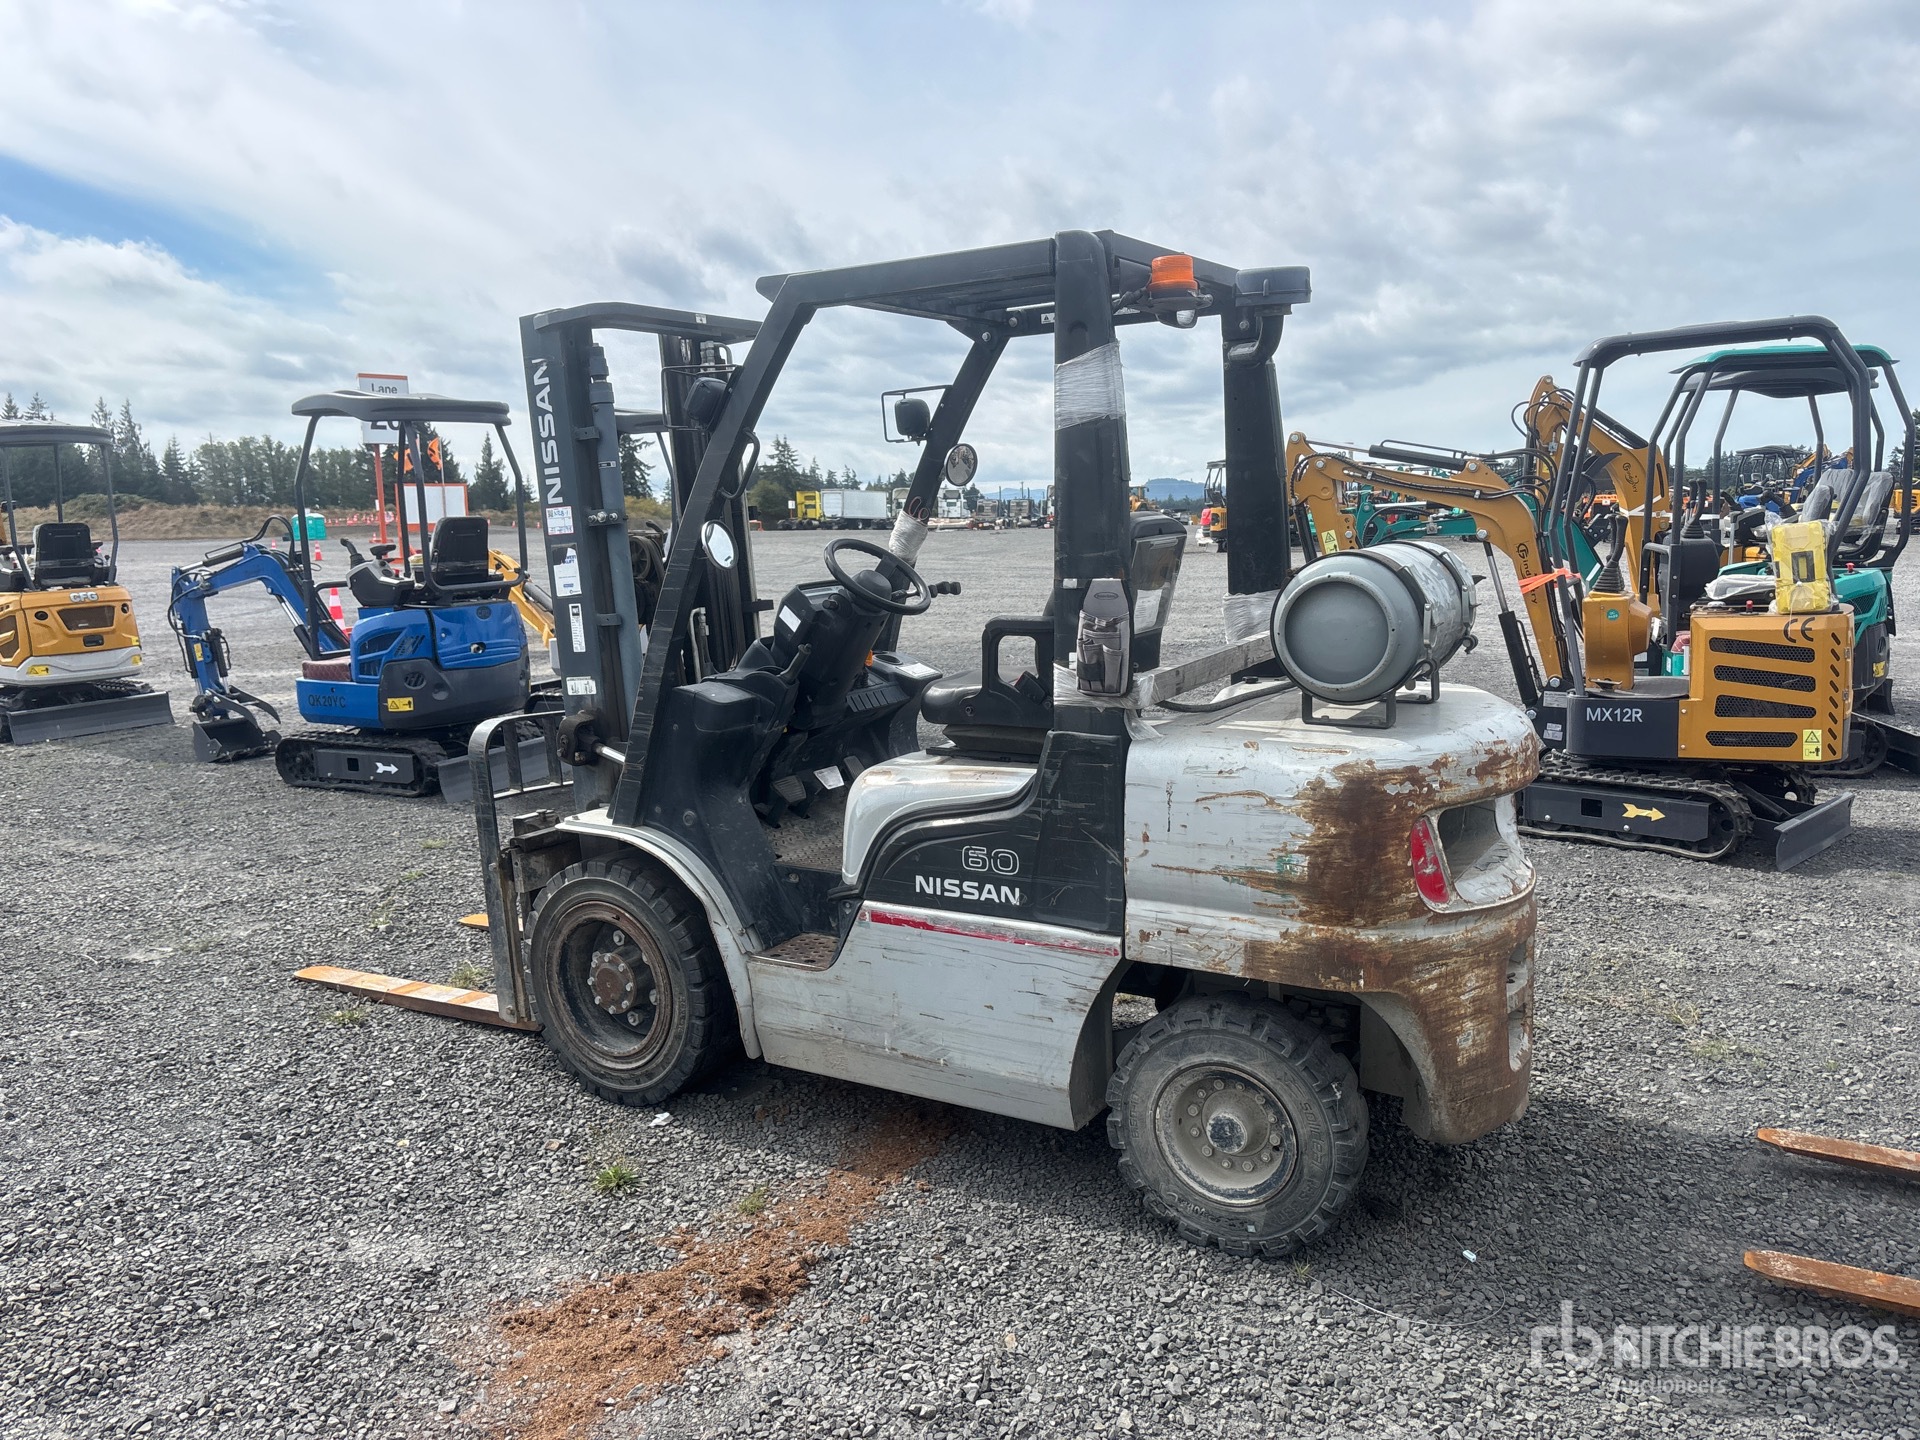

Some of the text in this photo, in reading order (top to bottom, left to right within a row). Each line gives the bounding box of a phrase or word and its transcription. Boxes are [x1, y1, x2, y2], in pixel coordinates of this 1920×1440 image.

[371, 382, 398, 394] Lane
[531, 358, 564, 505] NISSAN
[69, 591, 98, 603] CFG
[308, 694, 346, 709] QK20YC
[1586, 707, 1643, 723] MX12R
[961, 845, 1020, 876] 60
[915, 875, 1020, 906] NISSAN
